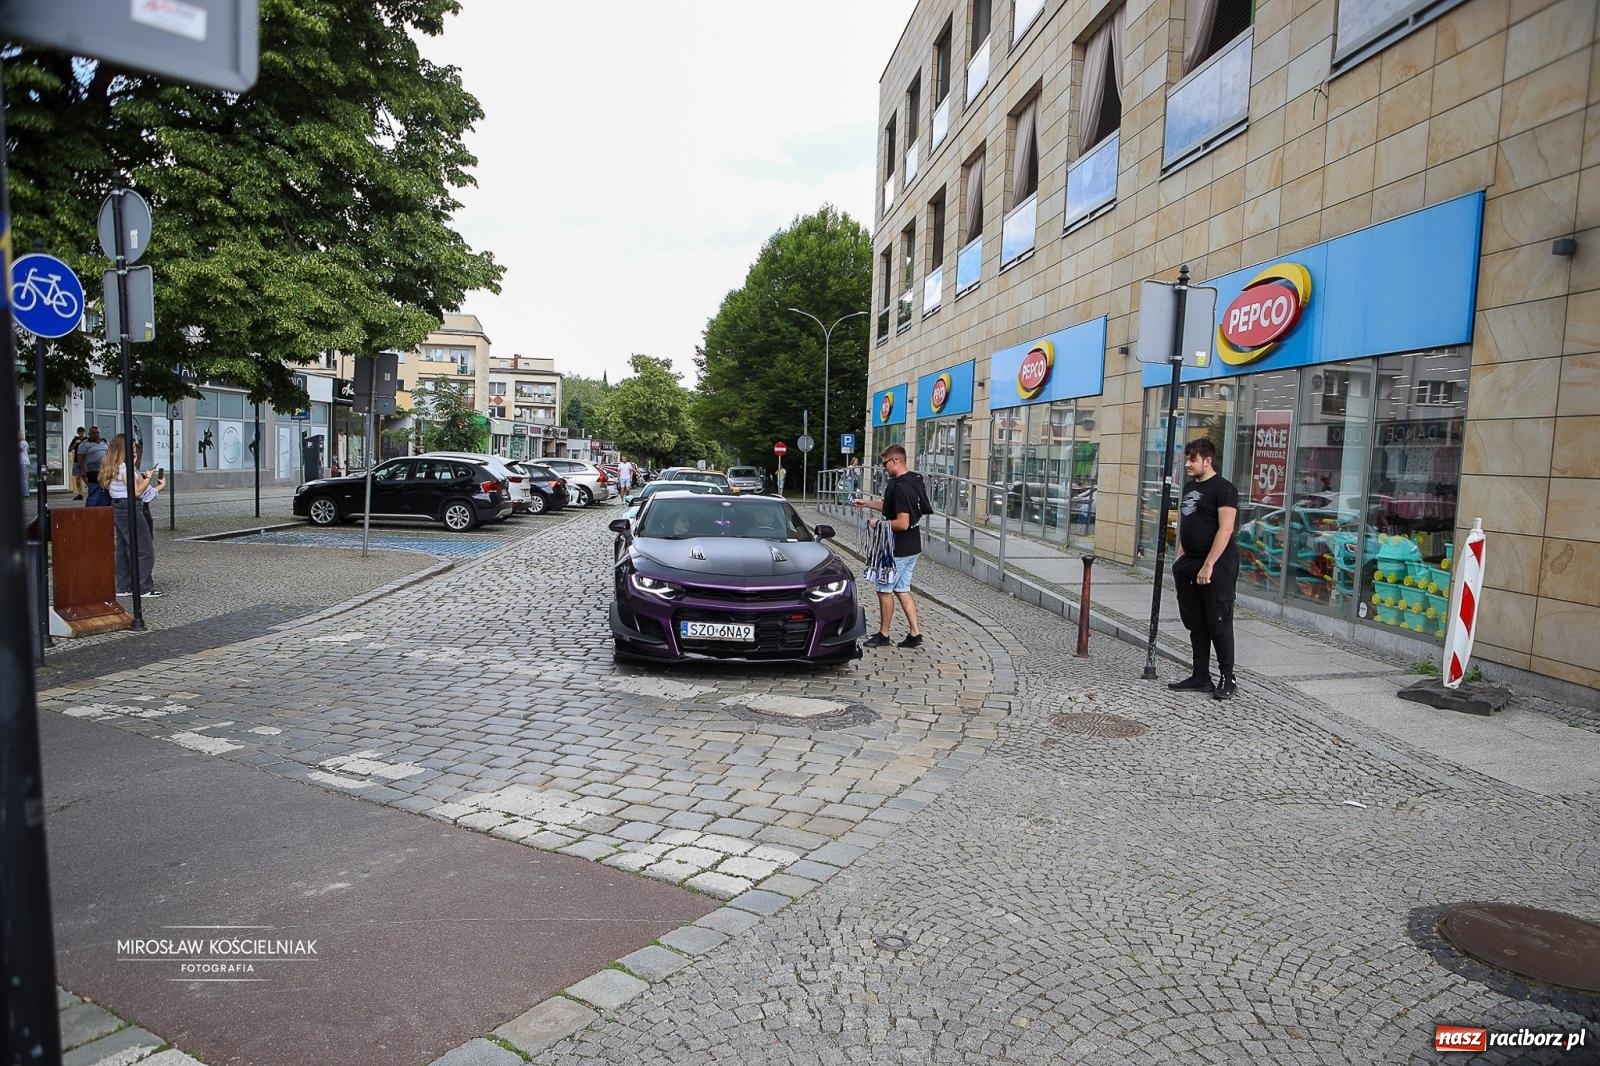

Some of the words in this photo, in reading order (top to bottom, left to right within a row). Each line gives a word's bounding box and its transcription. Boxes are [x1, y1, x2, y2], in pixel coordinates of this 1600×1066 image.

[1228, 295, 1288, 335] PEPCO
[1022, 359, 1044, 381] PEPCO
[73, 391, 83, 401] 2-4
[844, 435, 852, 446] P
[1257, 428, 1288, 449] SALE
[1254, 463, 1285, 490] -50%
[690, 624, 715, 636] SZO
[719, 625, 751, 638] 6NA9
